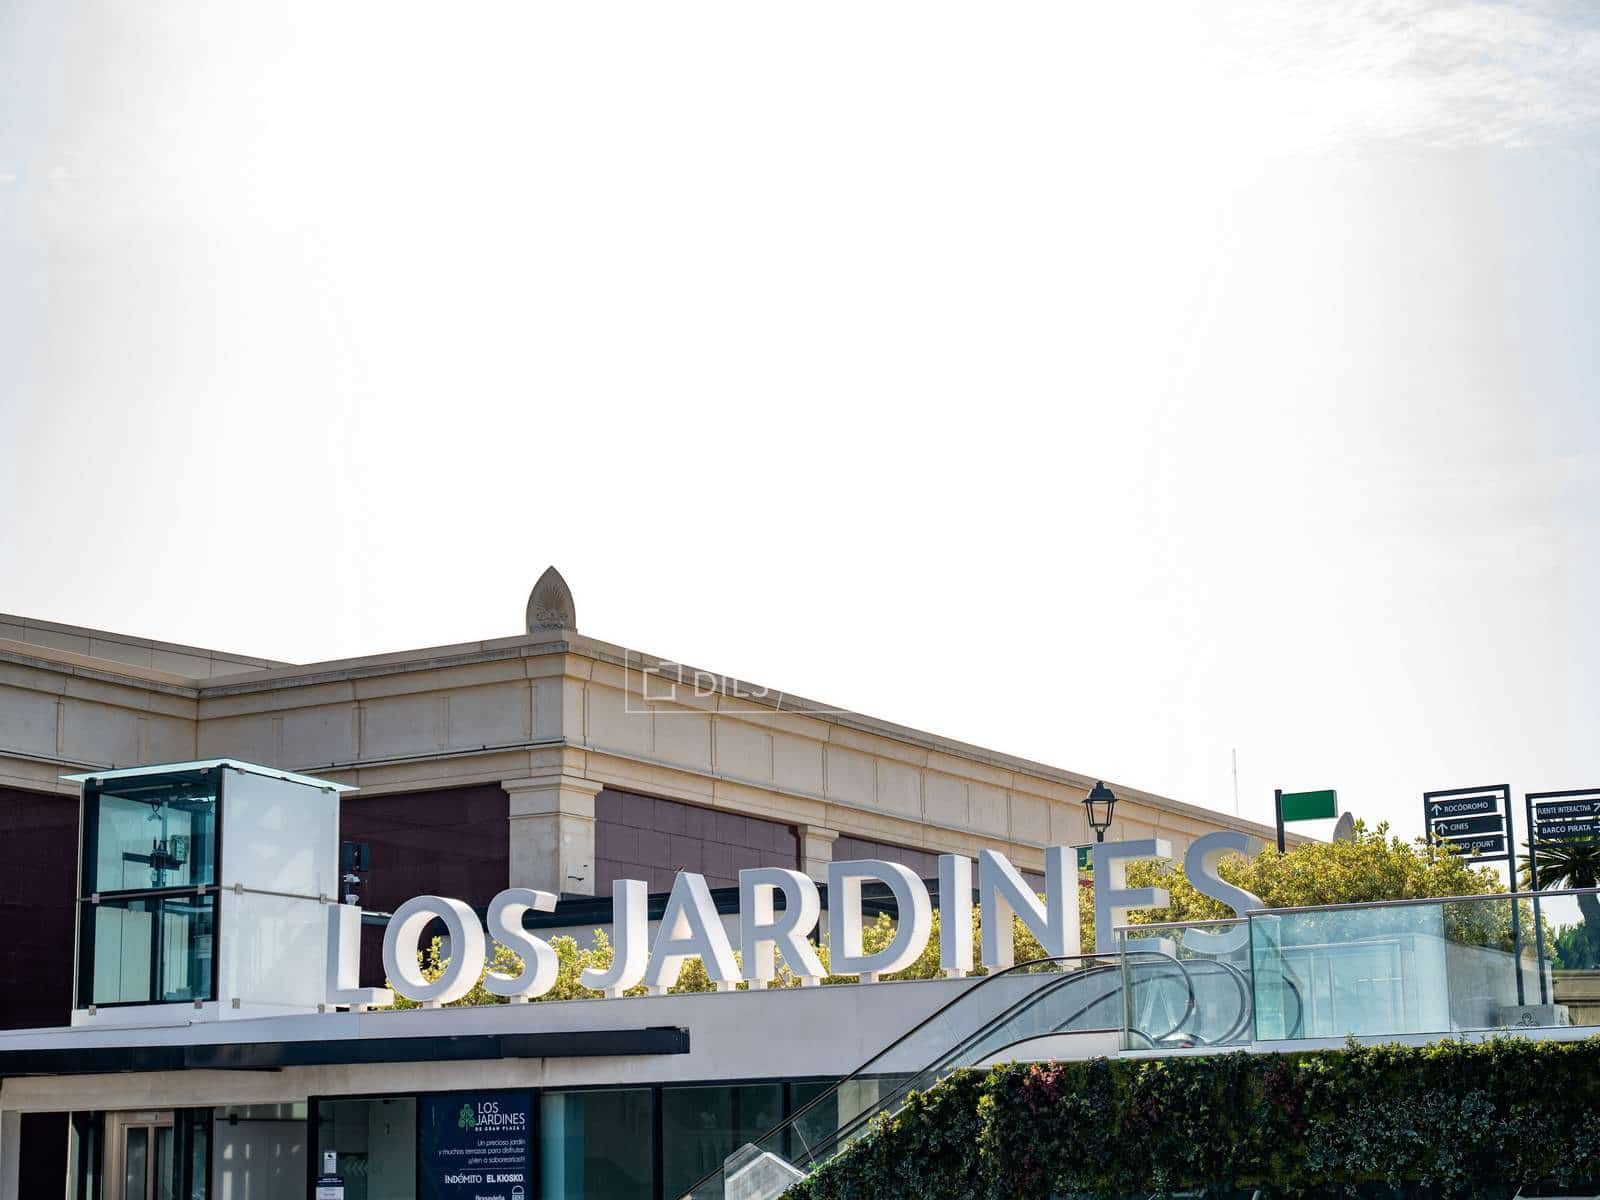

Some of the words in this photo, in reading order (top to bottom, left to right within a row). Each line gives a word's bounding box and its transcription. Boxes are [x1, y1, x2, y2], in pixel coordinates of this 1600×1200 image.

[1537, 806, 1557, 815] FUENTE
[1558, 803, 1591, 814] INTERACTIVA
[1449, 822, 1470, 831] CINES
[1542, 826, 1566, 834] BARCO
[1568, 824, 1592, 833] PIRATA
[1471, 839, 1495, 849] COURT
[326, 888, 559, 1005] LOS
[578, 831, 1265, 990] JARDINES
[478, 1102, 499, 1113] LOS
[475, 1113, 525, 1125] JARDINES
[444, 1172, 482, 1184] INDÓMITO
[486, 1174, 496, 1183] EL
[496, 1173, 524, 1183] KIOSKO
